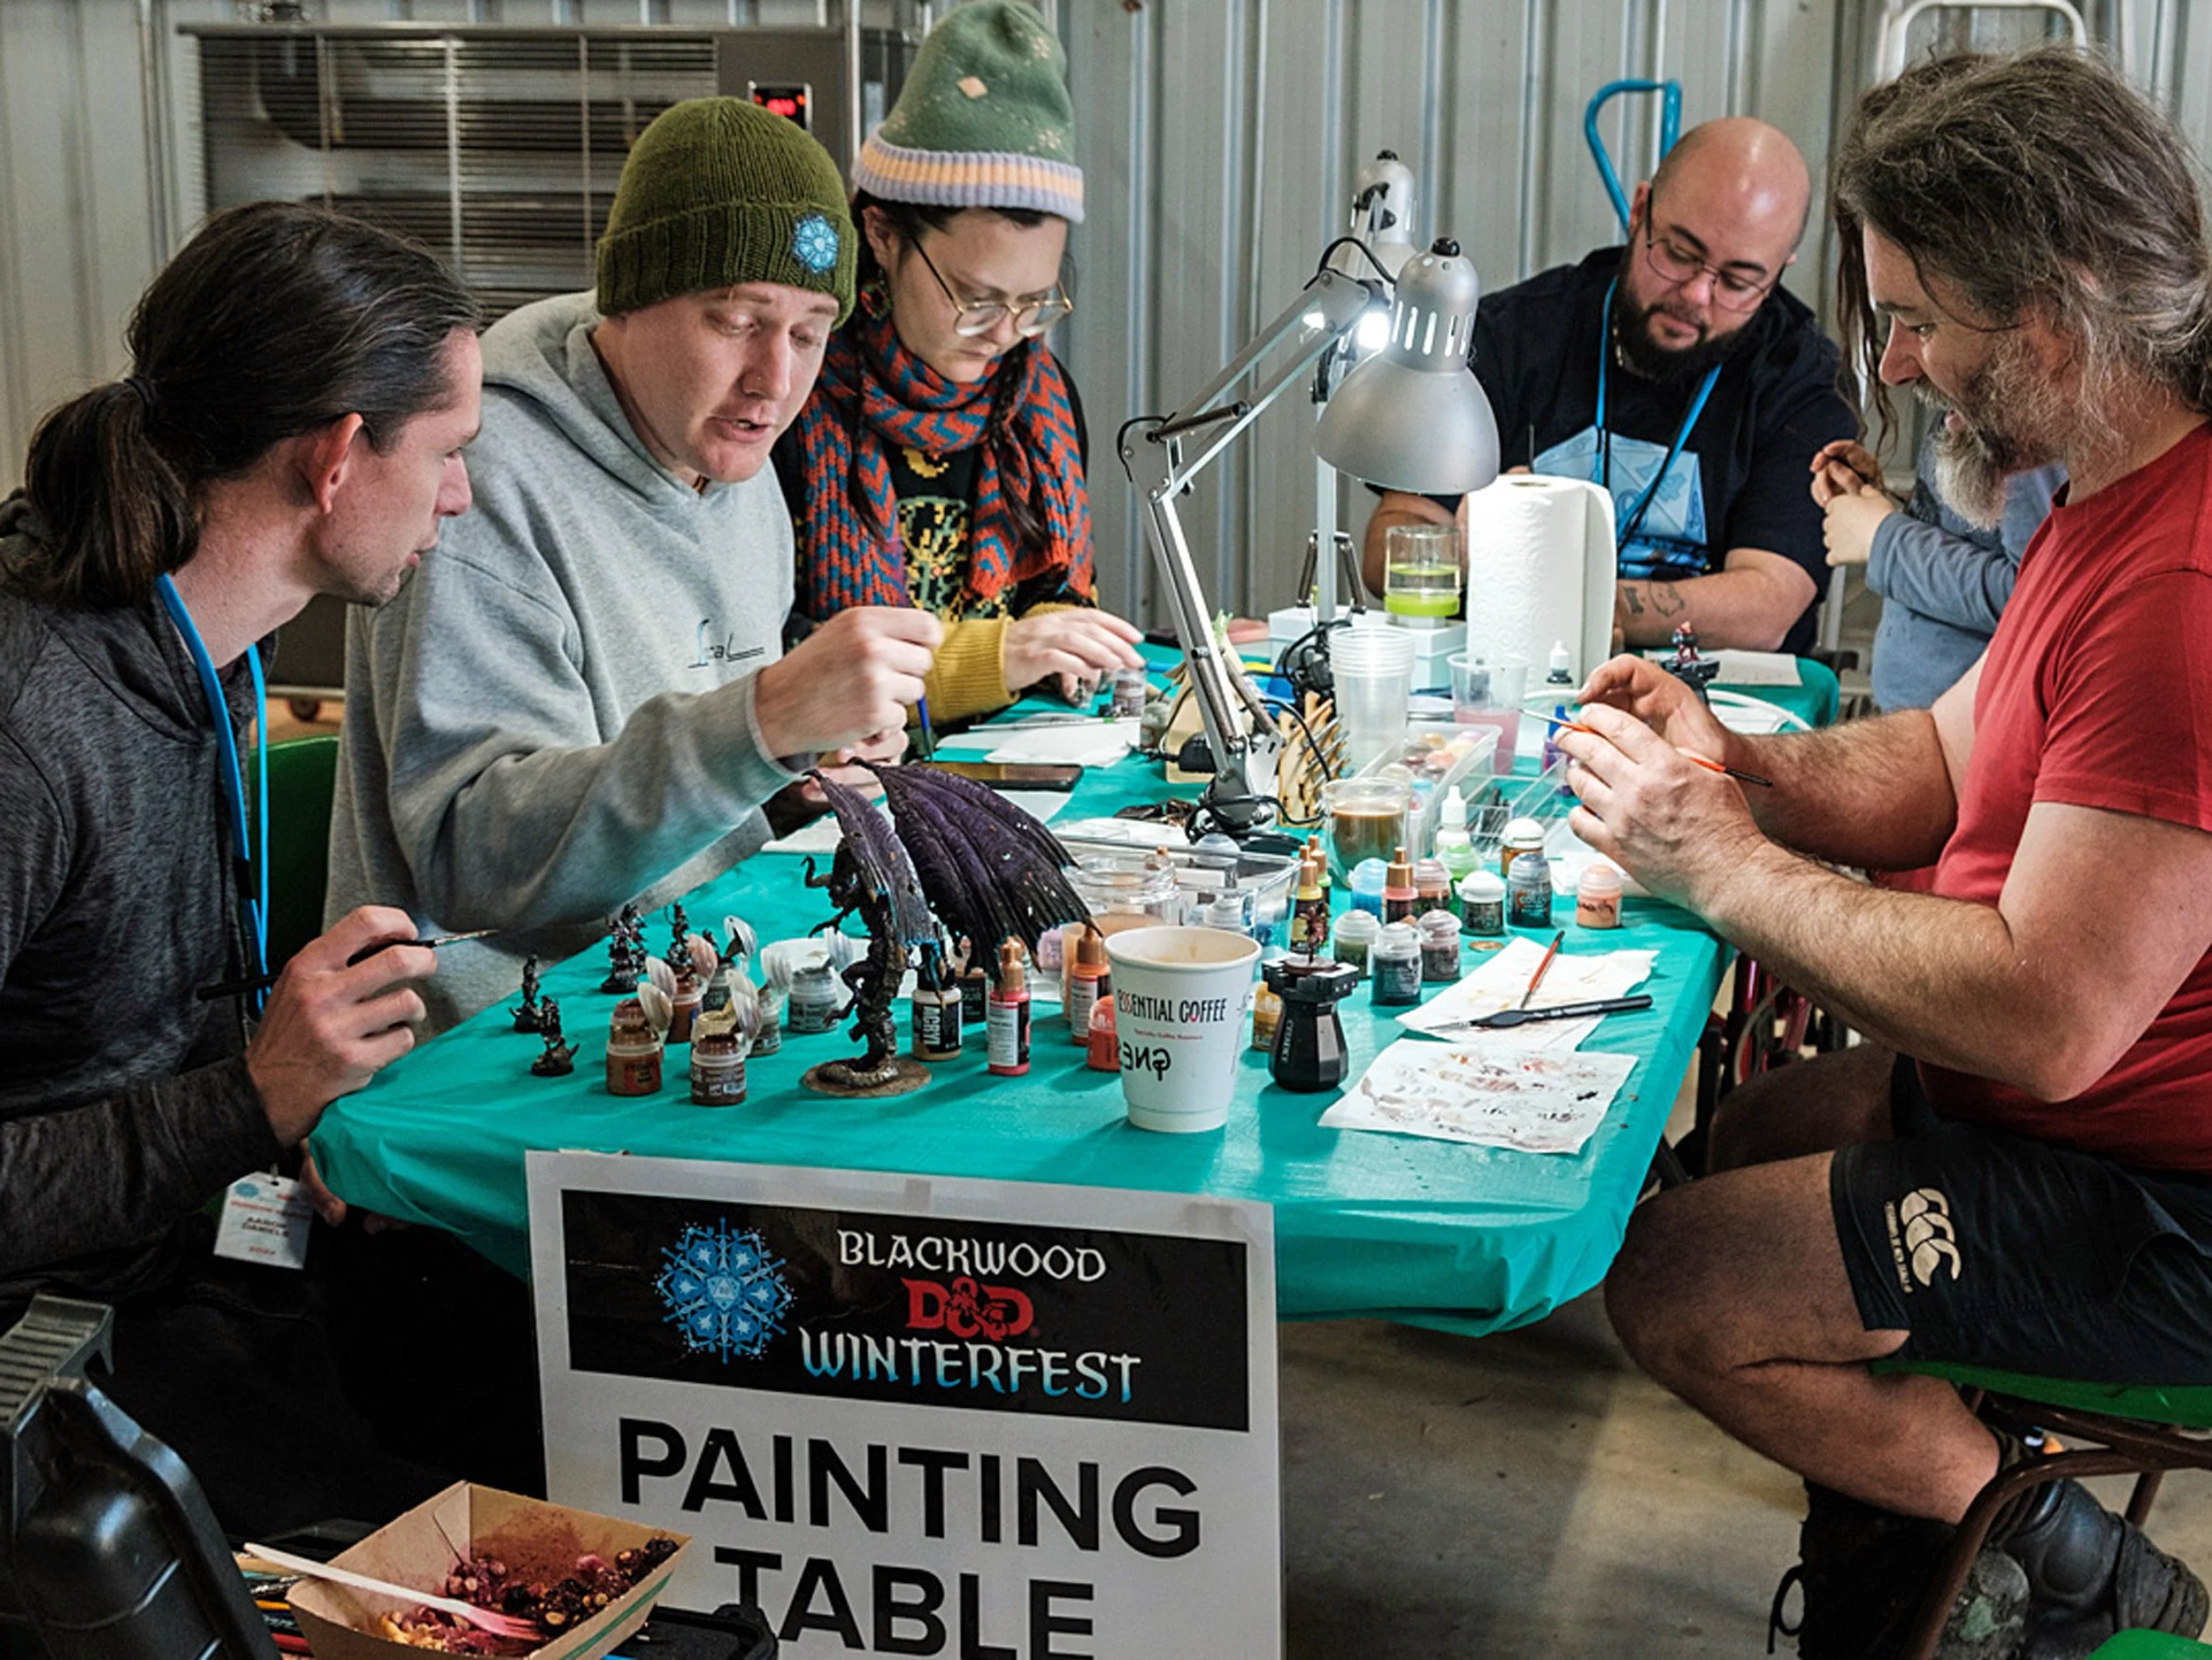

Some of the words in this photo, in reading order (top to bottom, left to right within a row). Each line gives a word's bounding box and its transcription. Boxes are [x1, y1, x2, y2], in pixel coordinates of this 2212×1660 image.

[1117, 988, 1174, 1023] ESSENTIAL
[1179, 998, 1227, 1023] COFFEE
[837, 1229, 1107, 1282] BLACKWOOD
[901, 1276, 1034, 1341] D&D
[798, 1326, 1142, 1403] WINTERFEST
[618, 1416, 1202, 1560] PAINTING
[713, 1544, 1095, 1660] TABLE
